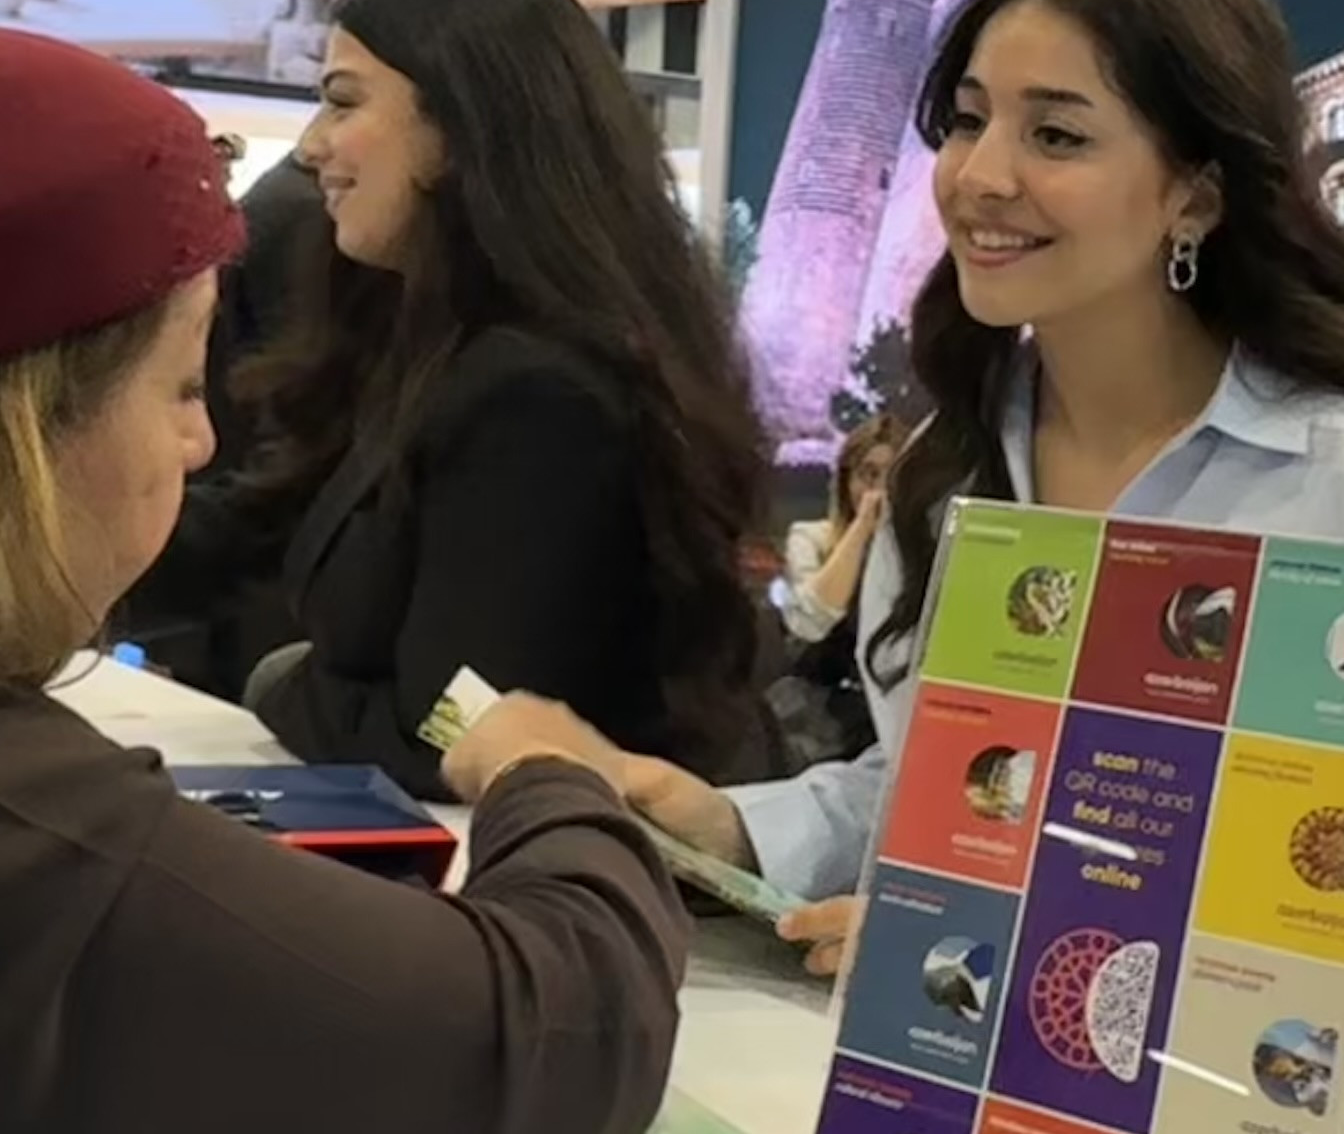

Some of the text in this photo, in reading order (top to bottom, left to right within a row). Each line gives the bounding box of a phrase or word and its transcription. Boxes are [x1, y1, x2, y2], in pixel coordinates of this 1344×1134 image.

[1091, 750, 1140, 773] scan
[1064, 770, 1194, 813] QR code and
[1080, 863, 1143, 891] online
